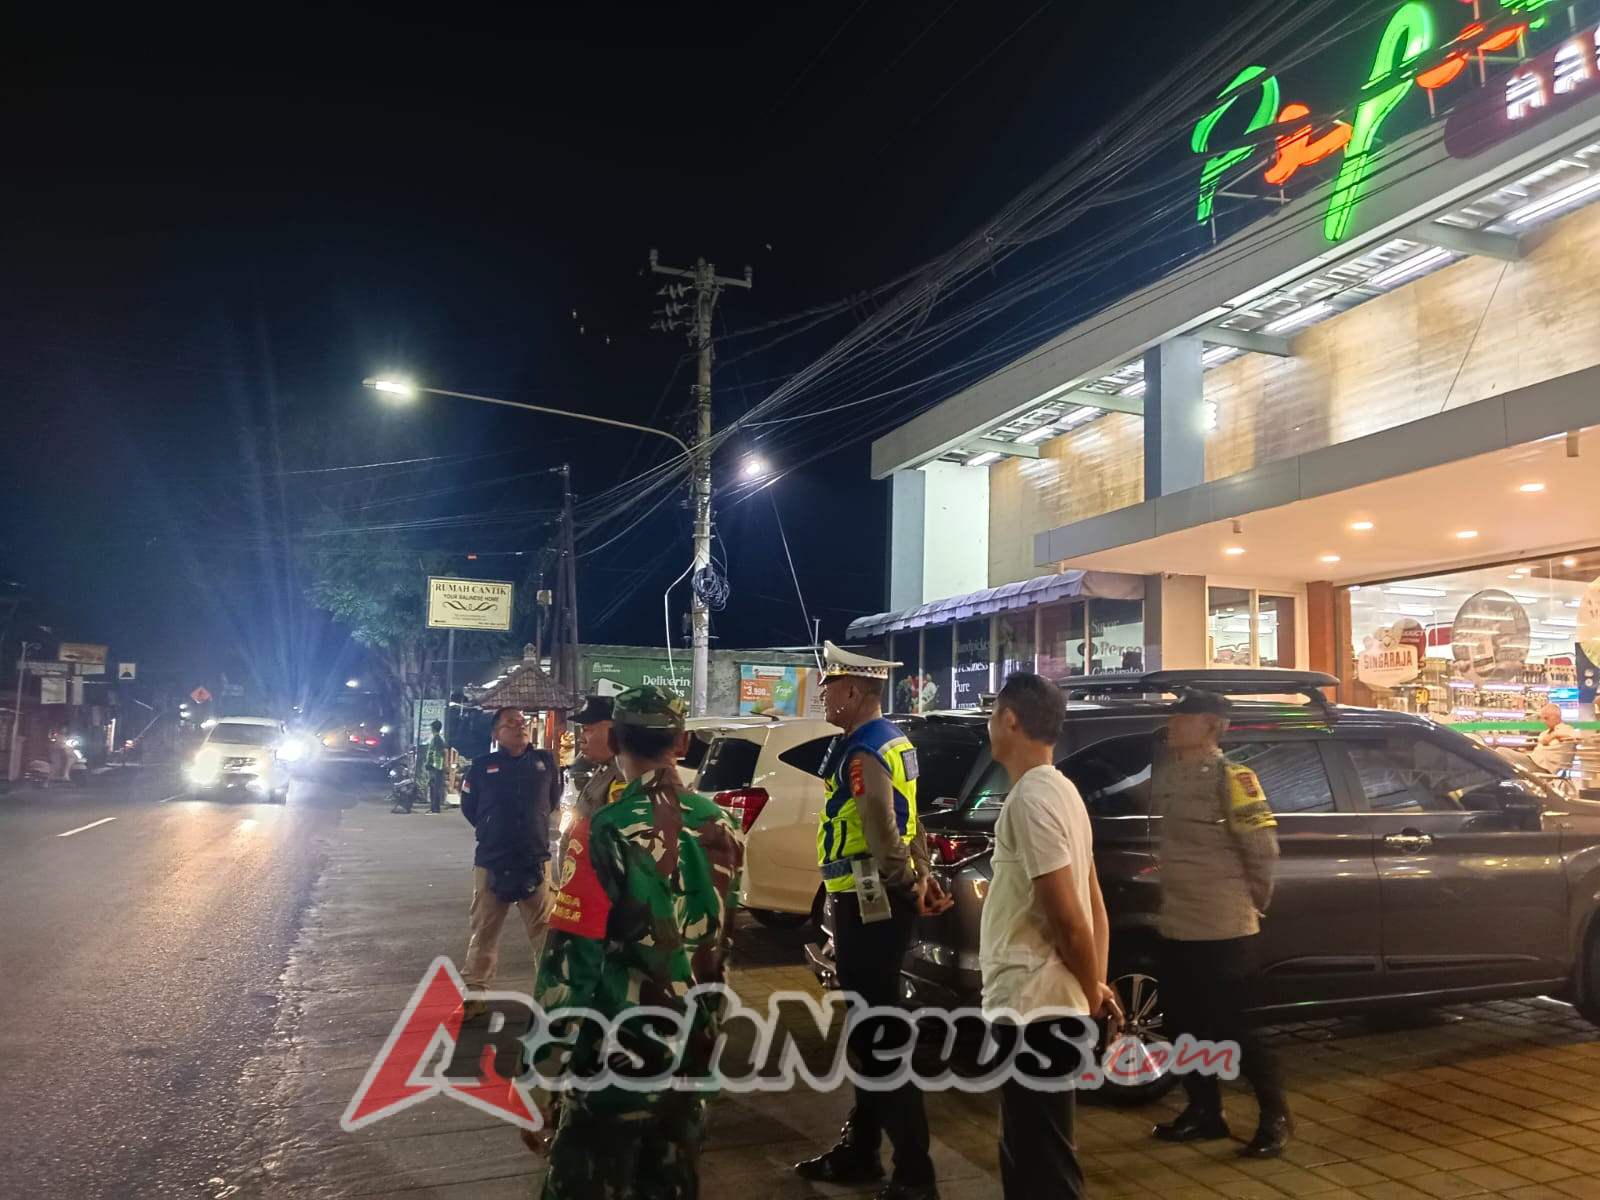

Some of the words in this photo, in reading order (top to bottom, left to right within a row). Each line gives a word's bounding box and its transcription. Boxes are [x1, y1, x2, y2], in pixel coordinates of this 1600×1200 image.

[1504, 22, 1600, 120] MA
[435, 583, 470, 593] RUMAH
[471, 585, 507, 596] CANTIK
[1363, 649, 1413, 670] SINGARAJA
